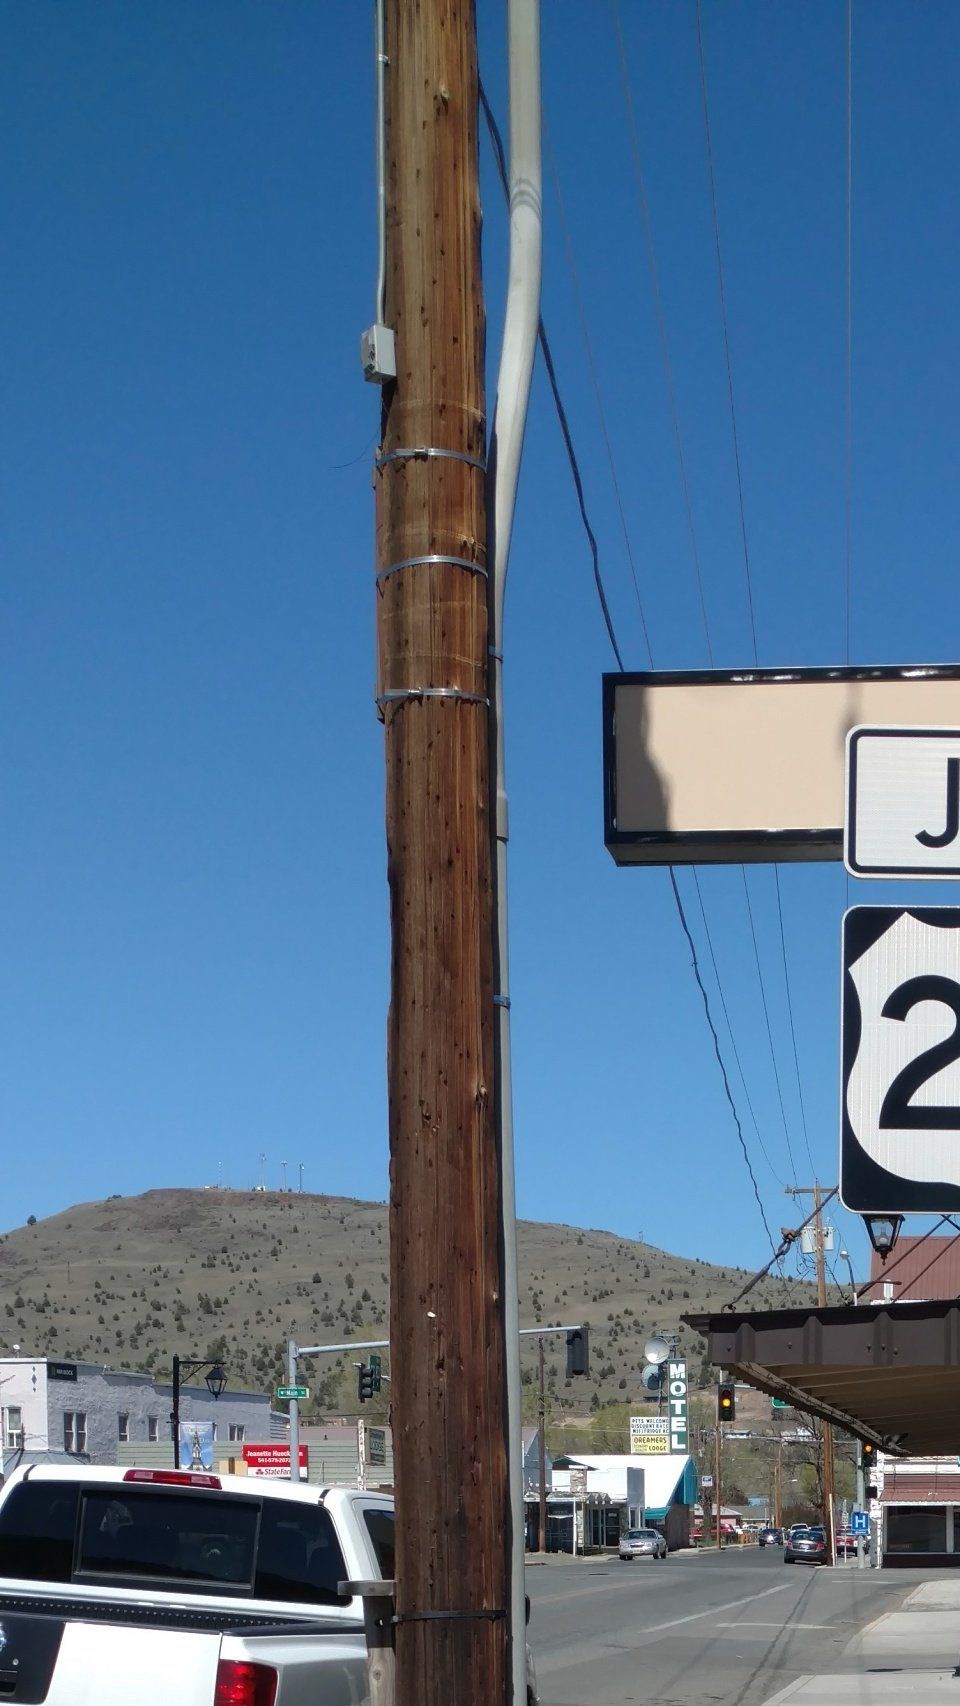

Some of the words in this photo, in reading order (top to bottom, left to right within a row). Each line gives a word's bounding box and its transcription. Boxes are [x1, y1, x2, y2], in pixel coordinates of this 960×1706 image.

[669, 1363, 687, 1449] MOTEL
[264, 1468, 292, 1476] StateFar
[855, 1515, 866, 1528] H
